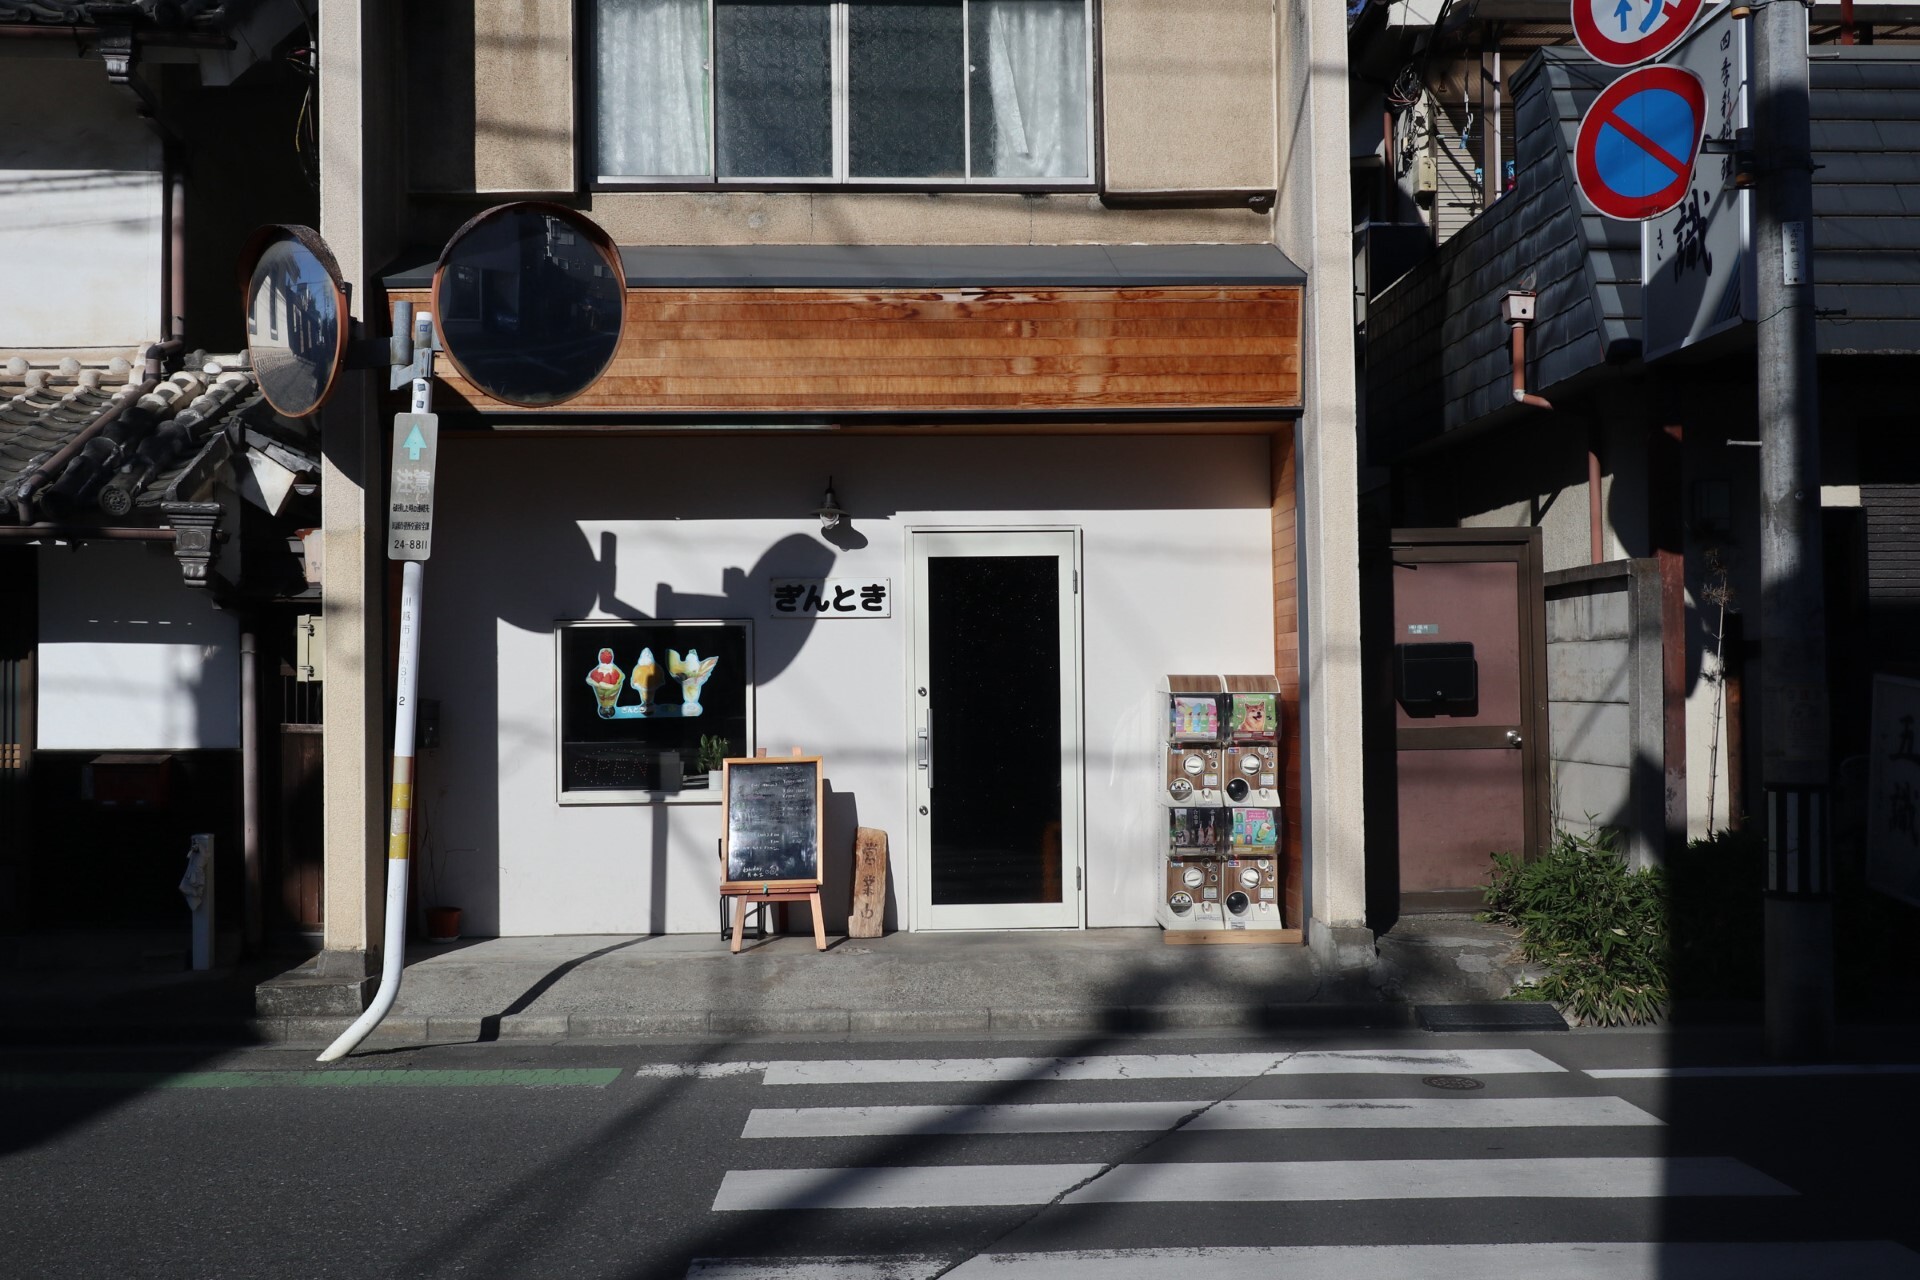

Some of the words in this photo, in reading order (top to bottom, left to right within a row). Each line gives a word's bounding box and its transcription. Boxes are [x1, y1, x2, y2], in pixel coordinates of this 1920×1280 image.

[396, 468, 431, 494] 注意
[393, 539, 428, 550] 24-8811
[774, 583, 887, 613] ぎんとき
[574, 758, 649, 777] OPEN
[860, 842, 878, 920] 営業中
